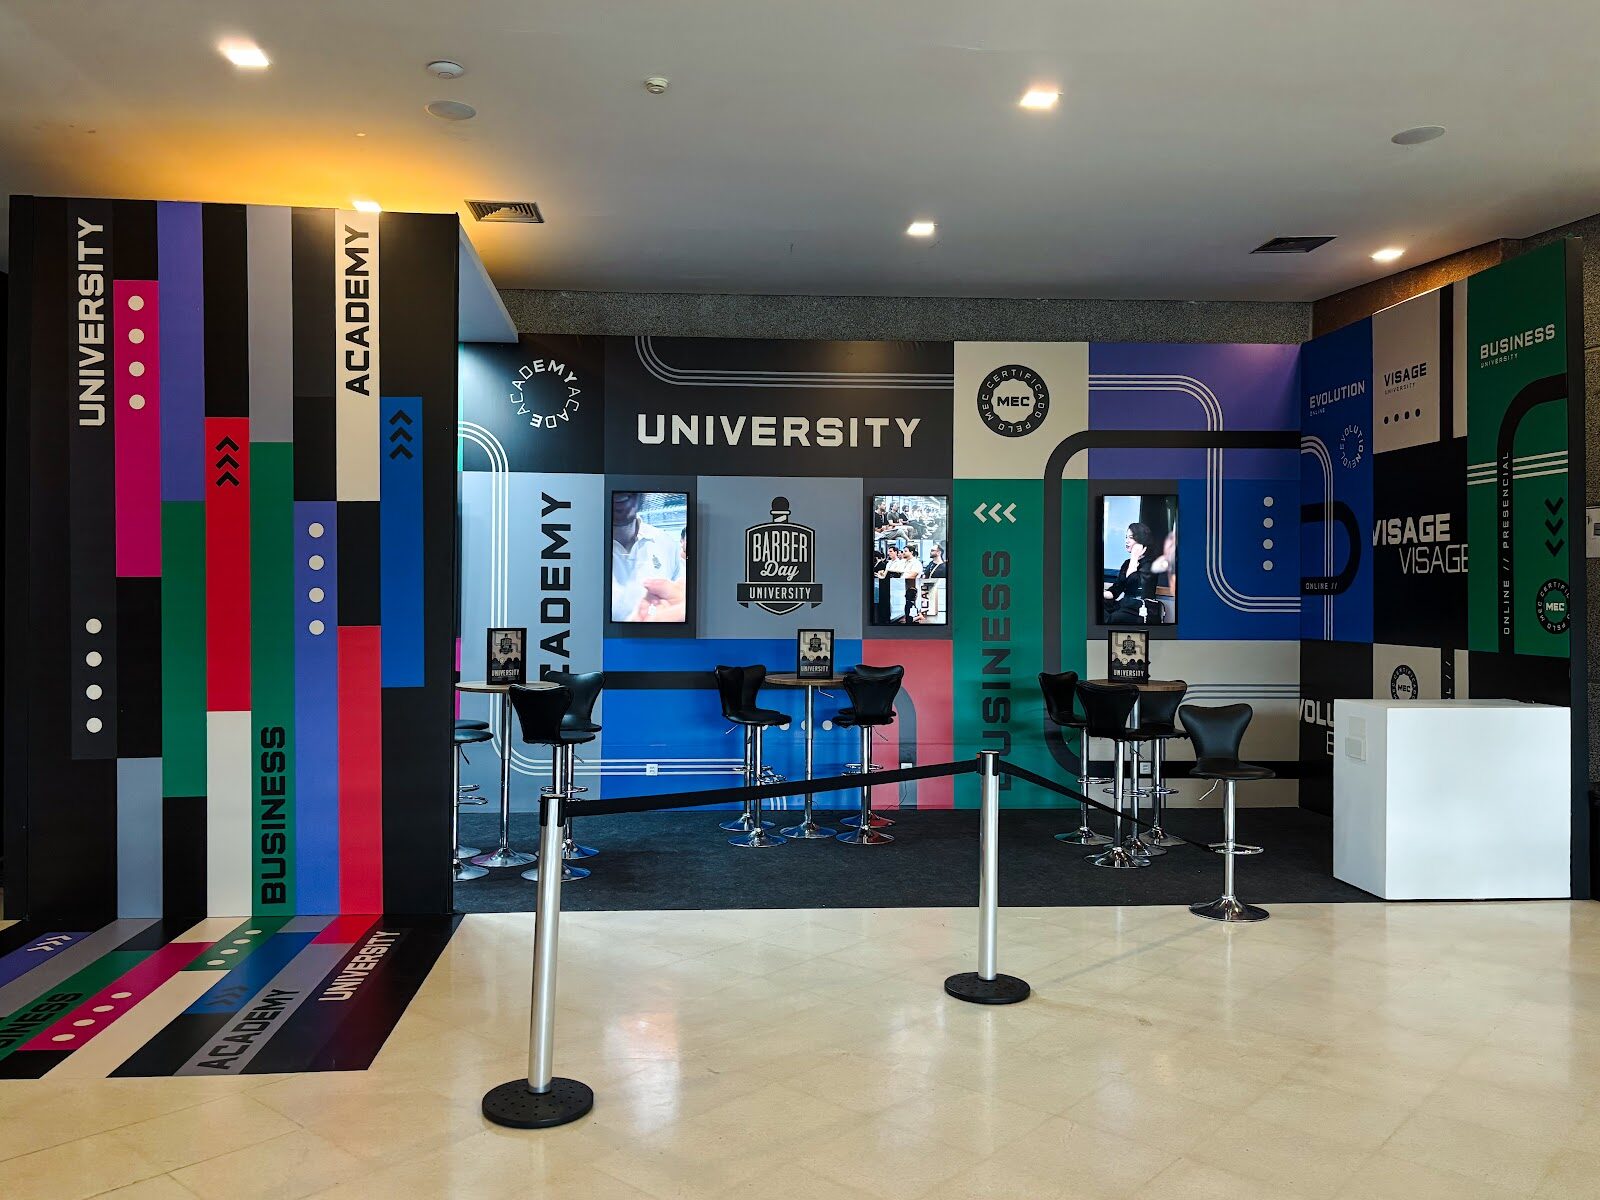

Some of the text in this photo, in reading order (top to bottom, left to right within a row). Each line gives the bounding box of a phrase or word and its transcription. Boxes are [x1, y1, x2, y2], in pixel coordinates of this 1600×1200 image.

[77, 217, 106, 427] UNIVERSITY
[344, 224, 370, 397] ACADEMY
[1480, 323, 1555, 360] BUSINESS
[1384, 362, 1427, 387] VISAGE
[1480, 353, 1518, 368] UNIVERSITY
[982, 369, 1045, 433] CERTIFICADO PELO MEC
[997, 396, 1030, 407] MEC
[1309, 380, 1365, 409] EVOLUTION
[637, 413, 921, 448] UNIVERSITY
[1373, 513, 1450, 547] VISAGE
[752, 530, 808, 562] BARBER
[1399, 544, 1468, 574] VISAGE
[760, 560, 800, 581] Day
[1305, 582, 1329, 590] ONLINE
[749, 586, 812, 600] UNIVERSITY
[1545, 602, 1565, 611] MEC
[1113, 669, 1145, 677] UNIVERSITY
[260, 726, 286, 905] BUSINESS
[318, 930, 402, 1002] UNIVERSITY
[197, 988, 301, 1070] ACADEMY
